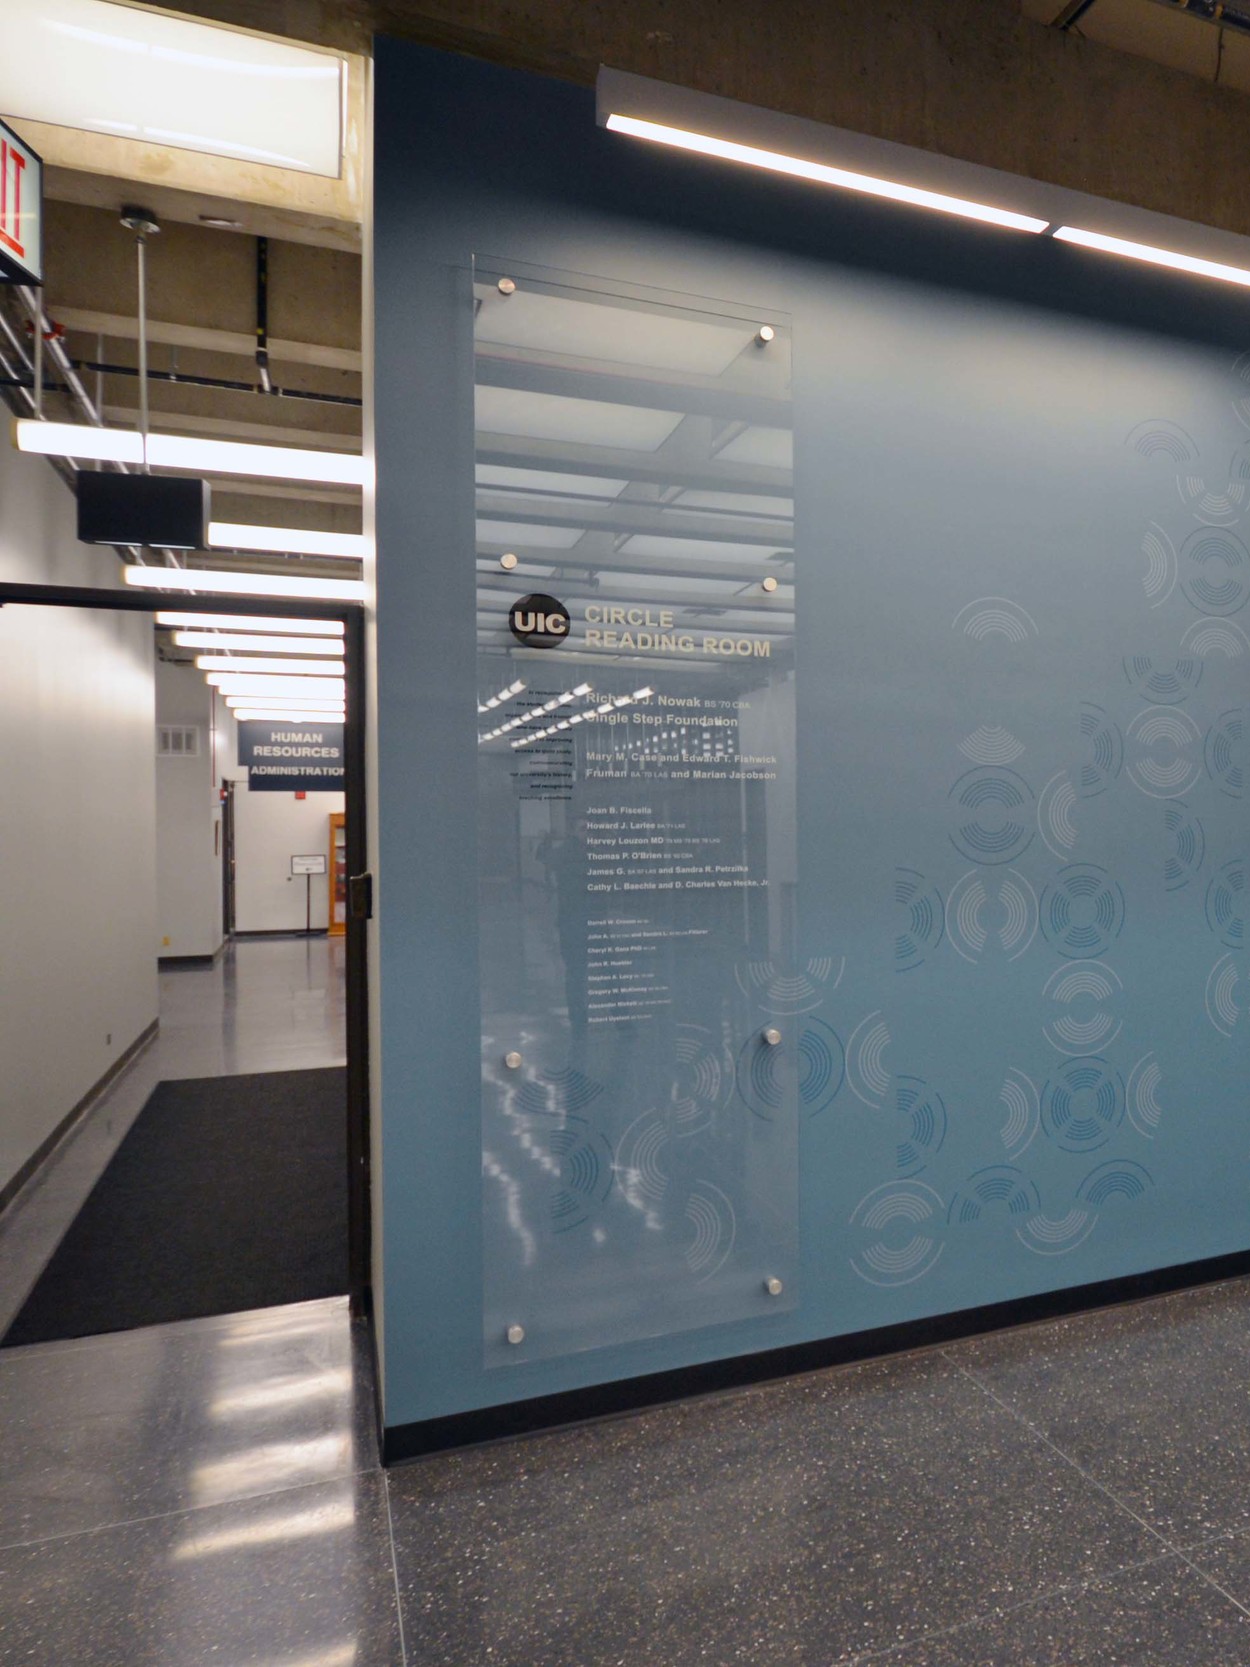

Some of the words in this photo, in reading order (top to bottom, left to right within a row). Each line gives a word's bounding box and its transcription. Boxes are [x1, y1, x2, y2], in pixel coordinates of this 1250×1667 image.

[0, 138, 26, 243] IT
[514, 611, 566, 634] UIC
[585, 605, 674, 628] CIRCLE
[585, 629, 695, 653] READING
[703, 637, 771, 658] ROOM
[586, 693, 638, 705] Richd
[642, 695, 654, 706] J.
[658, 695, 701, 708] Nowak
[704, 699, 717, 709] BS
[633, 713, 662, 728] Step
[666, 714, 738, 728] Foundation
[271, 732, 323, 743] HUMAN
[253, 745, 340, 758] RESOURCES
[586, 751, 613, 763] Mary
[616, 752, 627, 761] M.
[631, 752, 656, 761] Case
[660, 752, 679, 762] and
[682, 753, 720, 763] Edward
[734, 754, 776, 764] Fishwick
[586, 768, 627, 778] Fruman
[671, 768, 689, 779] and
[693, 769, 724, 779] Marian
[728, 770, 776, 780] Jacobson
[587, 806, 607, 814] Joan
[587, 822, 619, 830] Howard
[587, 838, 616, 846] Harvey
[587, 868, 614, 876] James
[659, 866, 674, 874] and
[675, 865, 703, 873] Sandra
[587, 883, 611, 892] Cathy
[658, 881, 673, 889] and
[686, 880, 715, 889] Charles
[717, 879, 733, 887] Van
